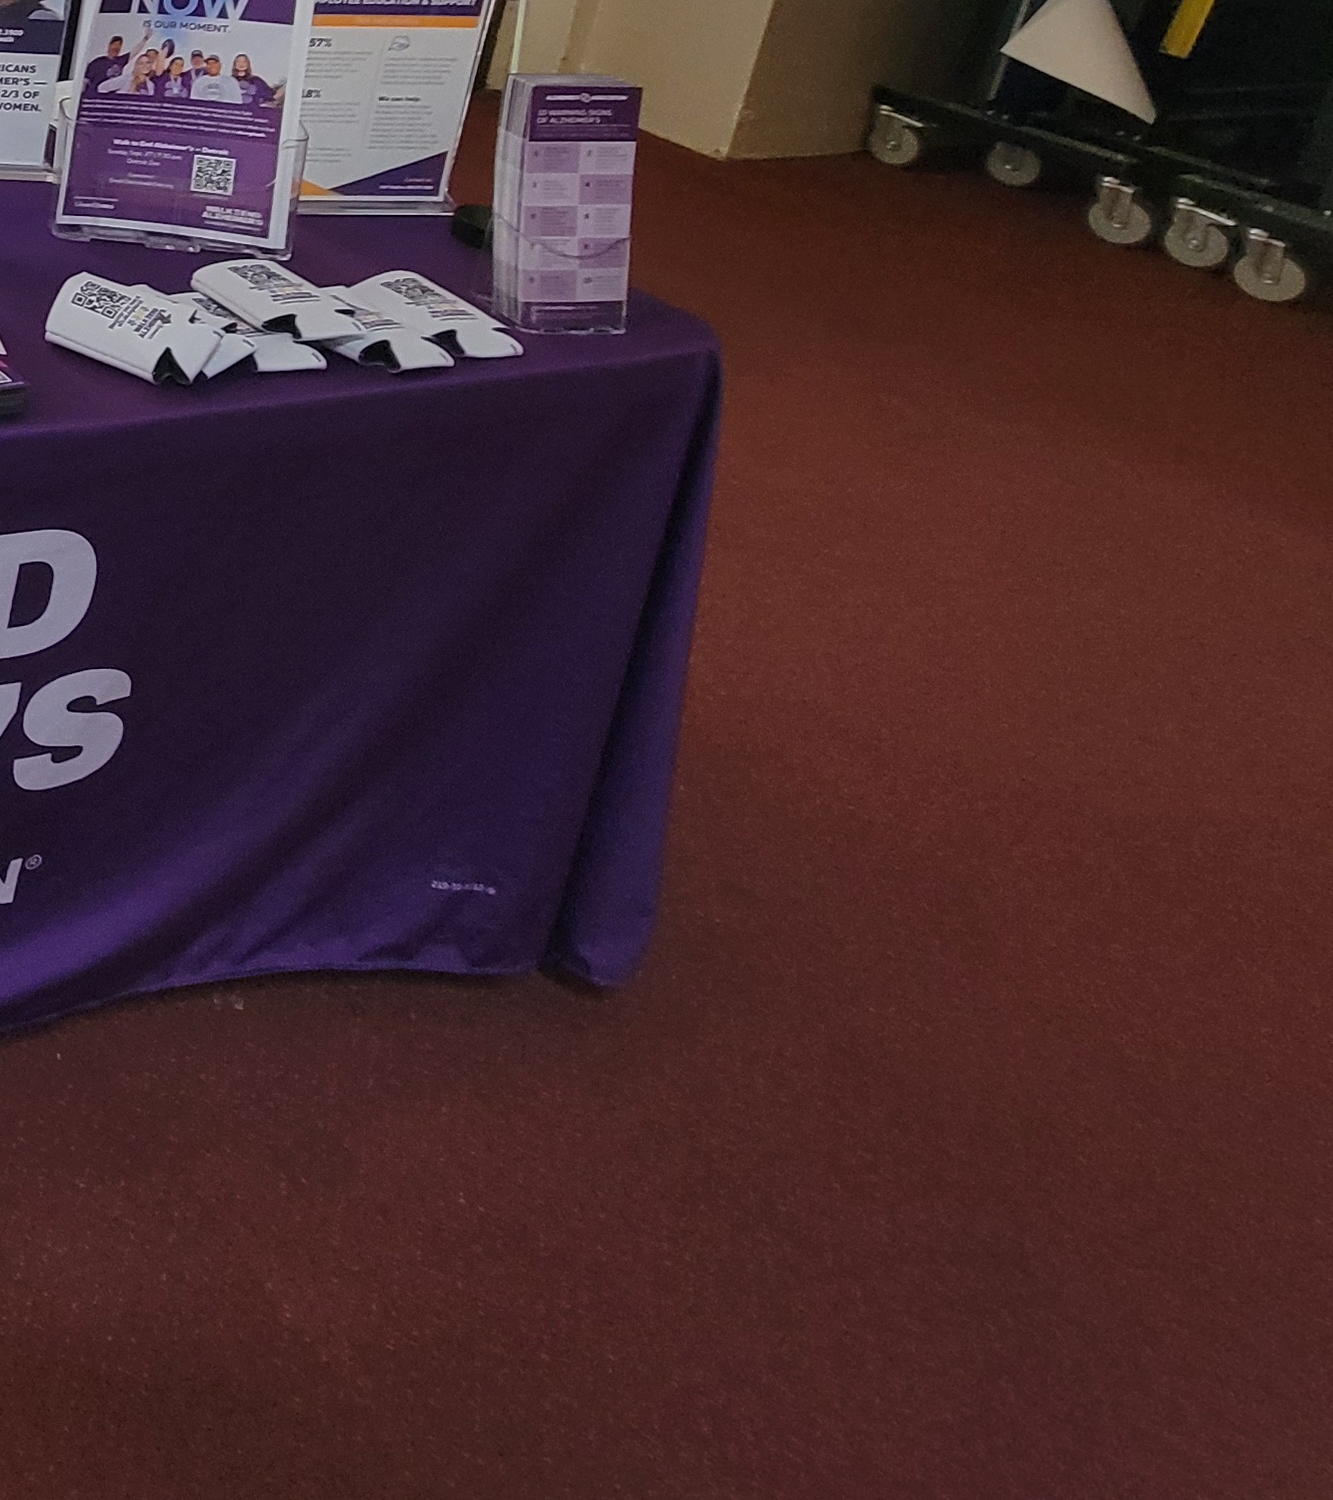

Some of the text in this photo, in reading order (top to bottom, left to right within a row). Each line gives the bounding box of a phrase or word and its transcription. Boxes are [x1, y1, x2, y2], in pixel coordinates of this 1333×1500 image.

[143, 20, 231, 33] IS OUR MOMENT.
[309, 38, 332, 47] 57%
[0, 89, 19, 98] 2/3
[23, 90, 40, 99] OF
